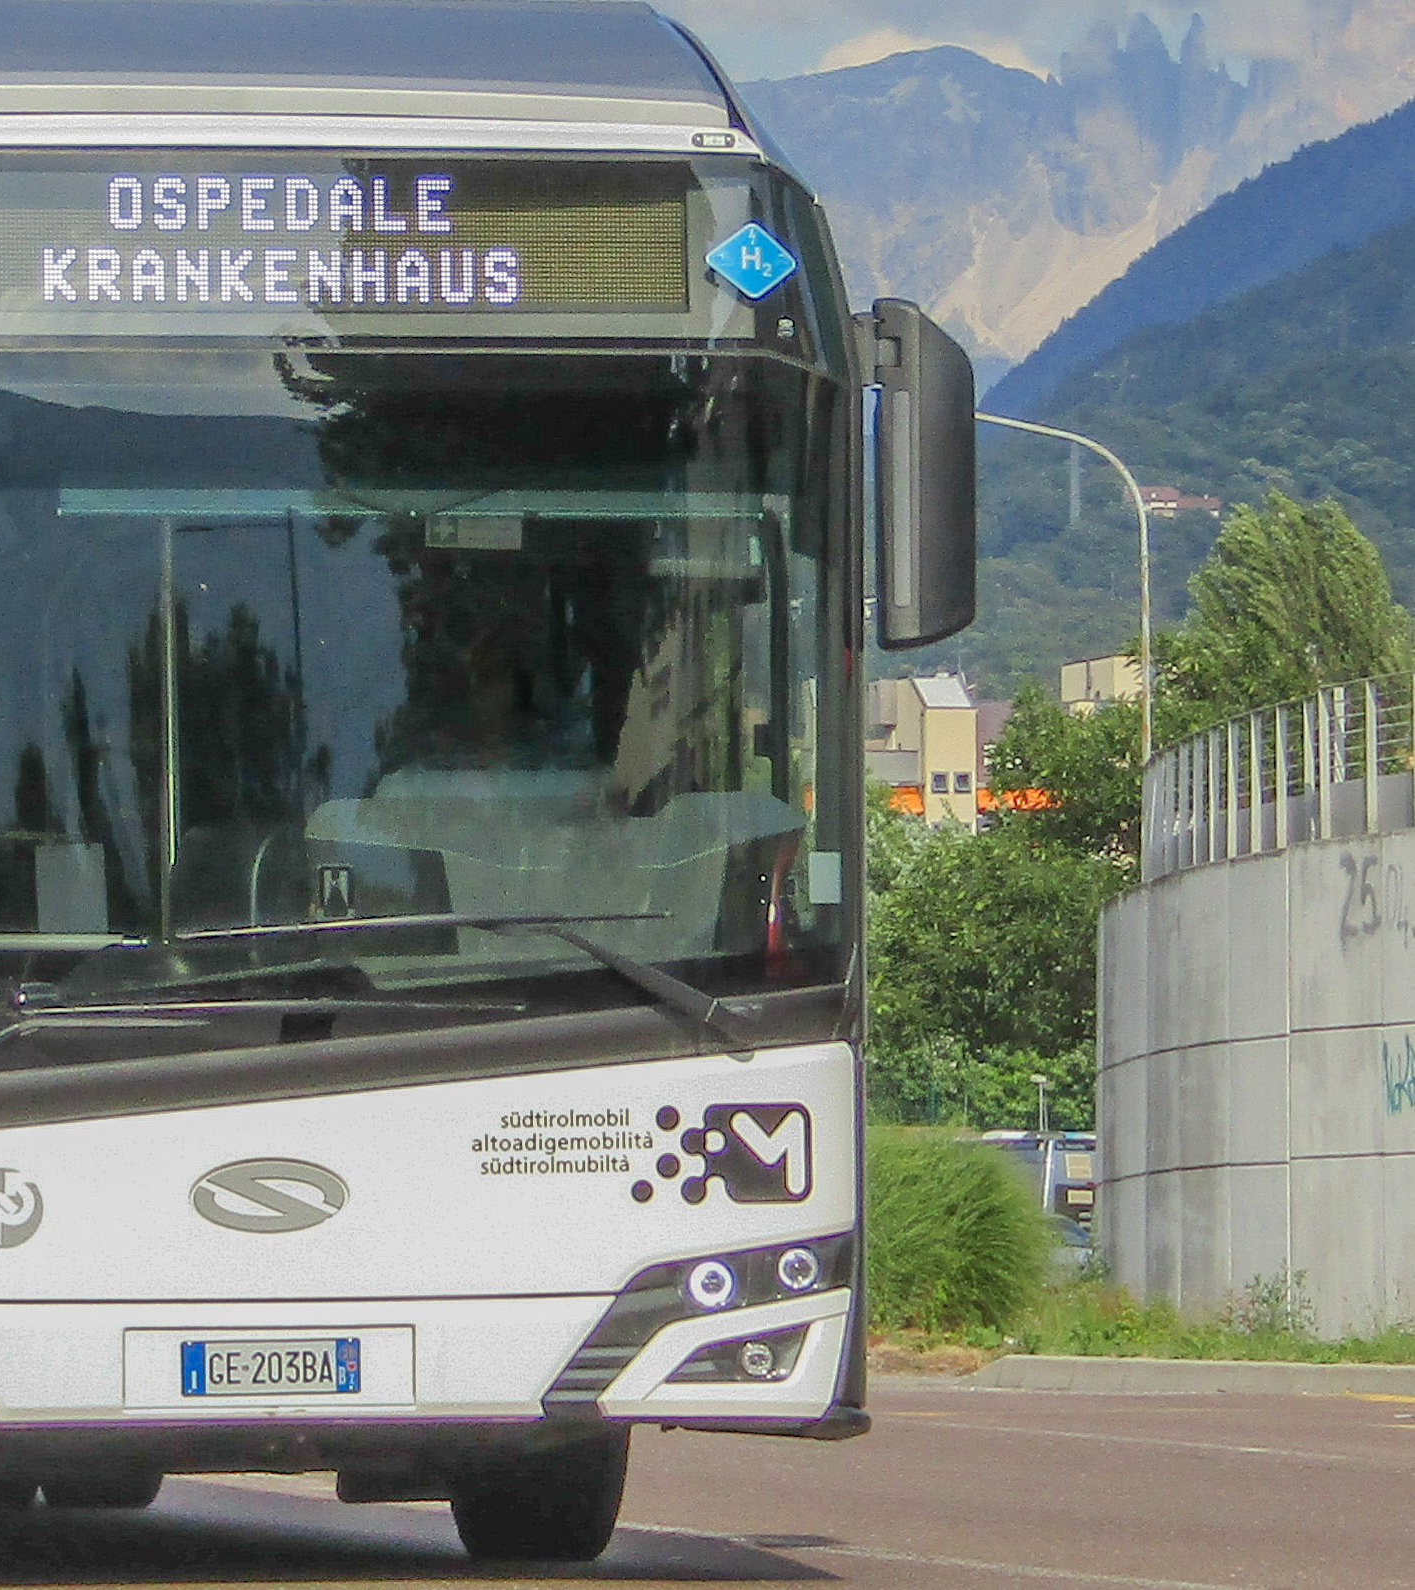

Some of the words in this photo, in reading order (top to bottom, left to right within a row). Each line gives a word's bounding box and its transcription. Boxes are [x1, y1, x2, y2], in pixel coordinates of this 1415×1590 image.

[107, 175, 453, 232] OSPEDALE
[41, 247, 520, 303] KRANKENHAUS
[500, 1109, 630, 1129] südtirolmobil
[471, 1131, 654, 1154] altoadigemobilità
[480, 1156, 630, 1176] südtirolmubiltà
